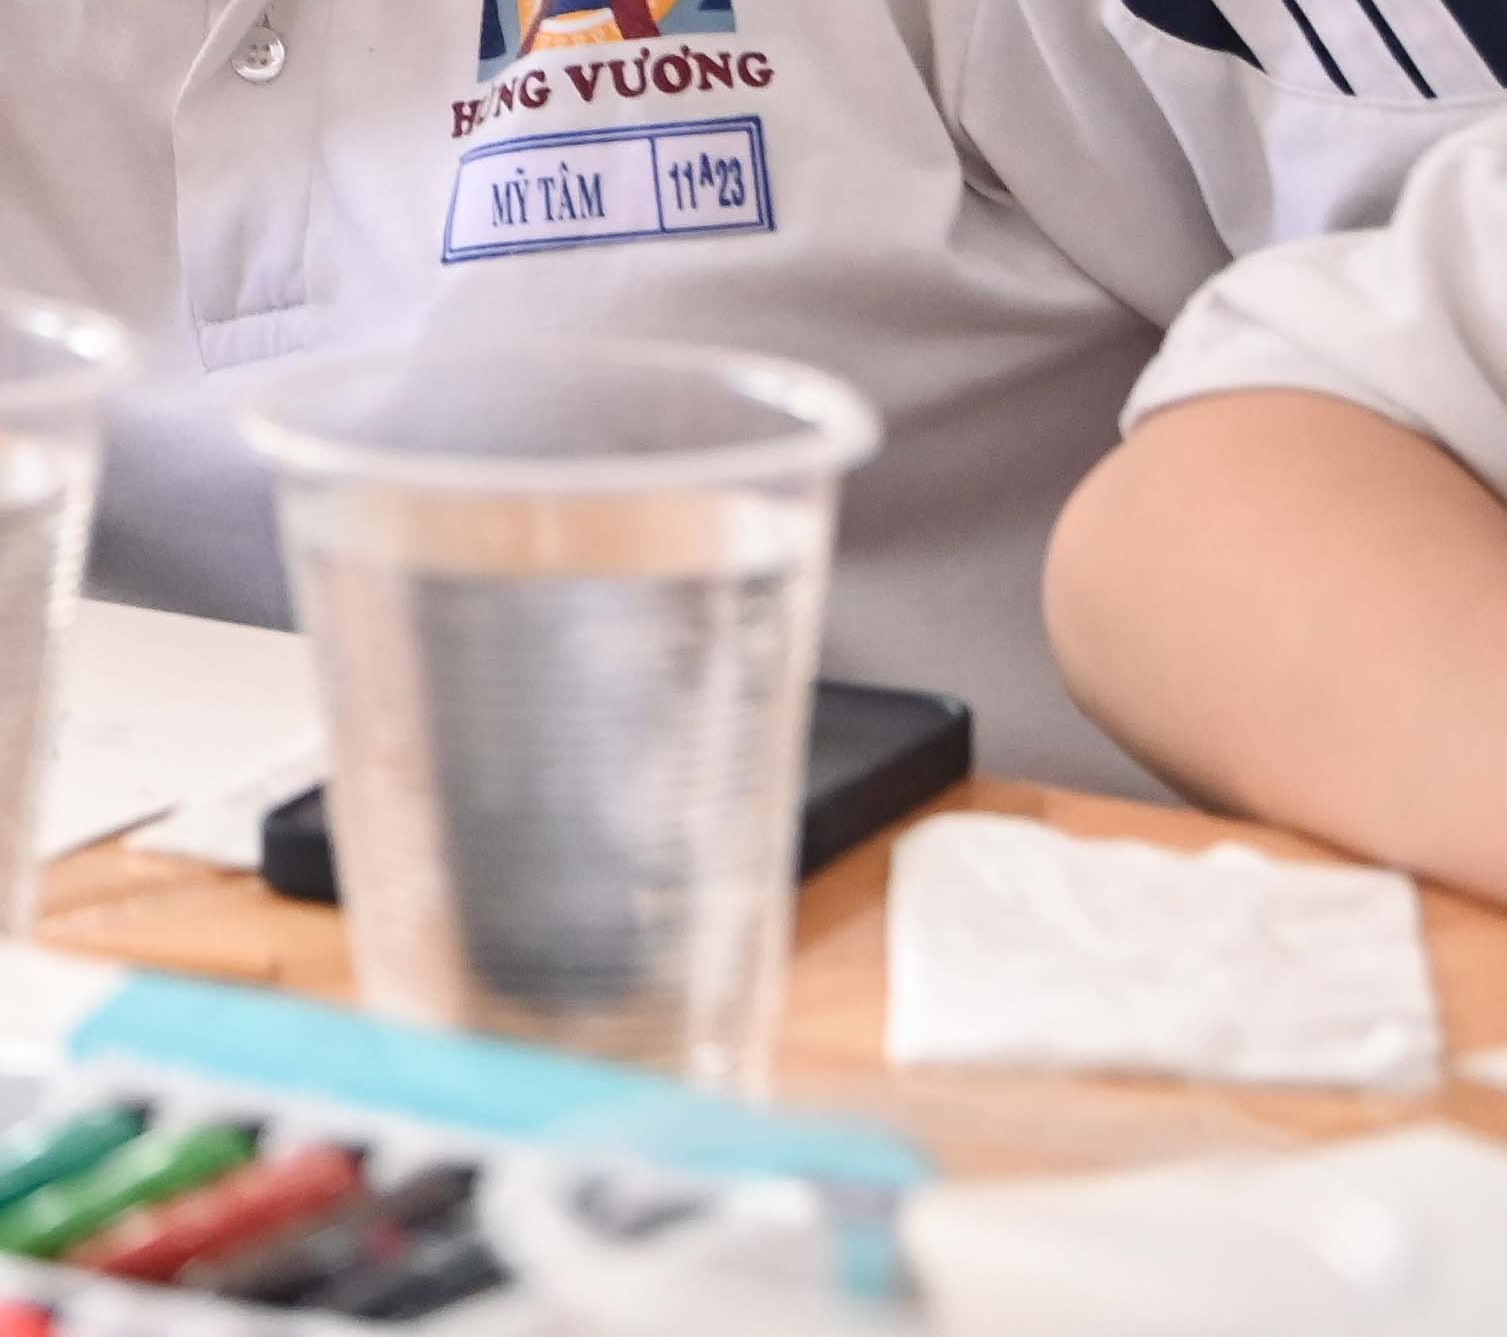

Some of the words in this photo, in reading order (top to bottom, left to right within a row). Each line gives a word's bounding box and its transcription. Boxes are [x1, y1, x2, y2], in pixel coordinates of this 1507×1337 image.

[451, 69, 551, 138] HNG
[564, 45, 774, 102] VƯƠNG
[491, 169, 529, 227] MỸ
[537, 165, 606, 223] TÂM
[669, 153, 746, 210] 11A23
